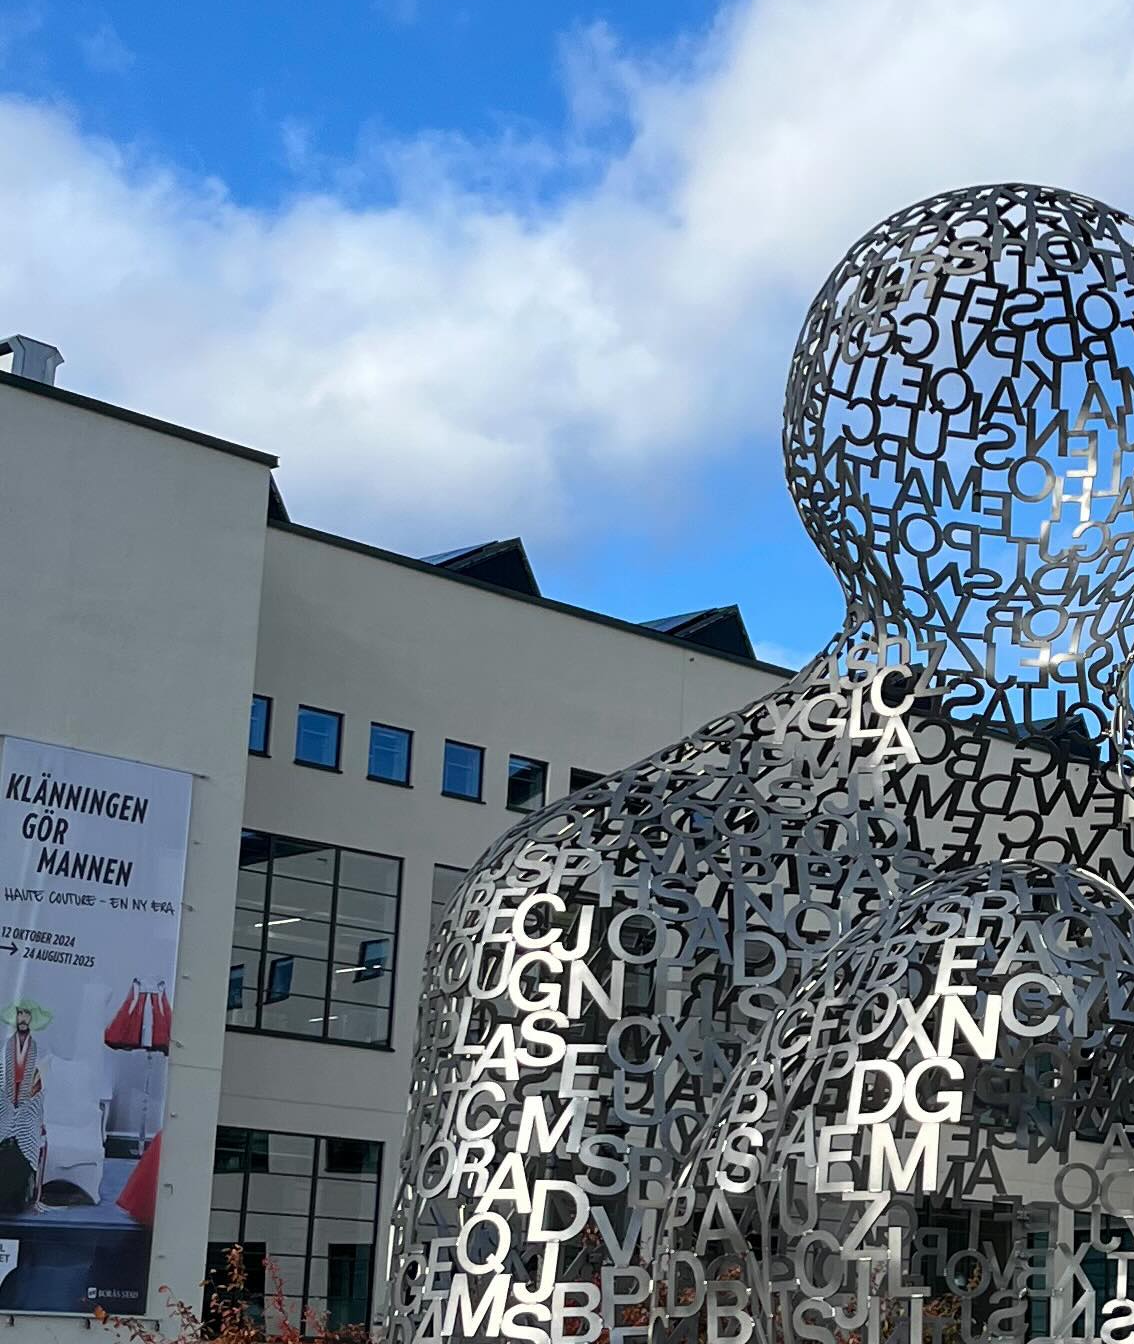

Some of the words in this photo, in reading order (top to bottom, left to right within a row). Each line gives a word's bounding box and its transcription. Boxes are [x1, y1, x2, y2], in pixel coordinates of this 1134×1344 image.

[6, 772, 149, 824] KLÄNNINGEN
[22, 809, 68, 845] GÖR
[36, 847, 133, 887] MANNEN
[4, 887, 44, 903] HAUTE
[49, 891, 96, 906] COUTURE
[110, 897, 128, 909] EN
[132, 898, 147, 911] NY
[1, 926, 12, 938] 12
[12, 928, 52, 944] OKTOBER
[53, 934, 76, 947] 2024
[23, 947, 35, 959] 24
[36, 949, 72, 964] AUGUSTI
[73, 955, 95, 968] 2025
